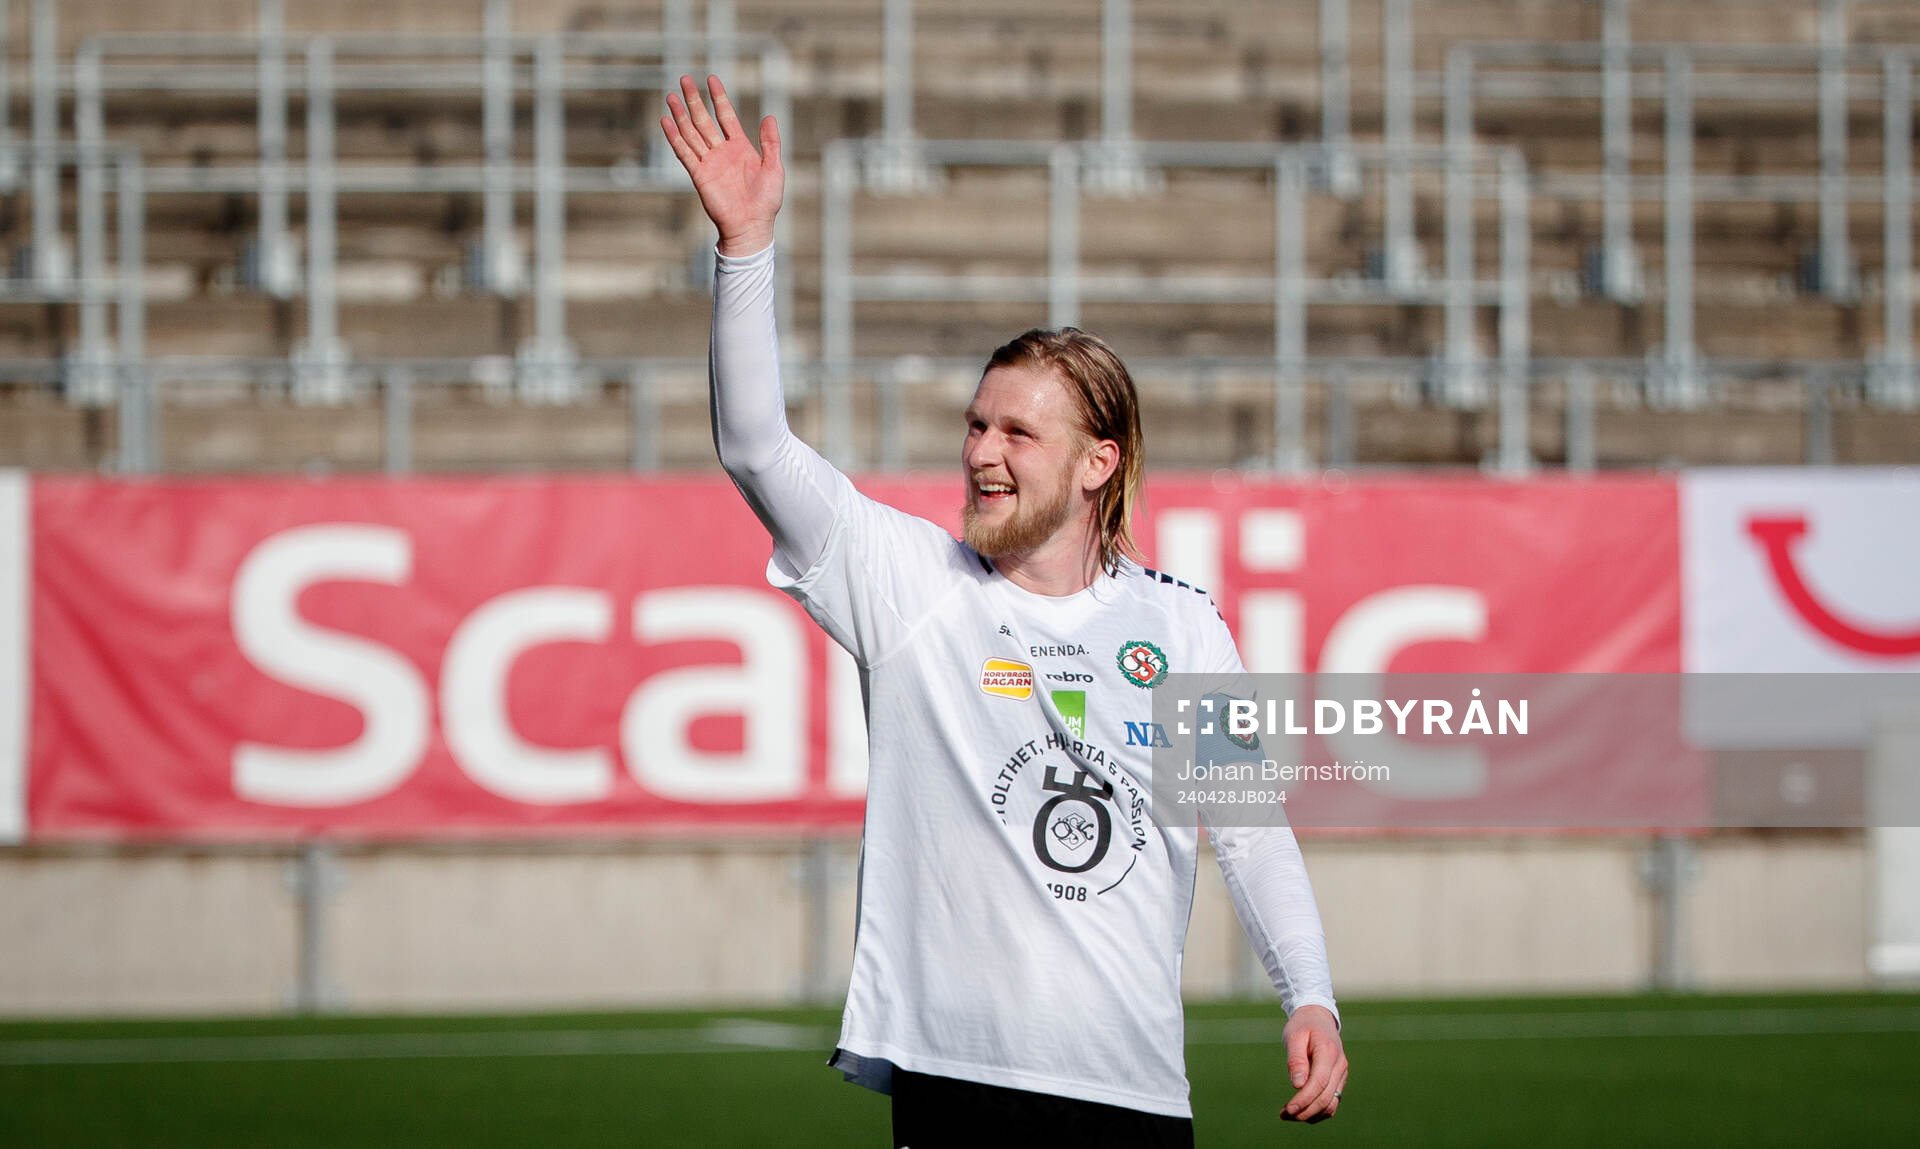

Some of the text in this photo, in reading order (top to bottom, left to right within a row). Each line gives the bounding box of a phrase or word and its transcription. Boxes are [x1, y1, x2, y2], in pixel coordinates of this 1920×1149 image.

[983, 678, 1031, 686] BAGARN
[1123, 721, 1173, 748] NA
[1120, 776, 1147, 852] PASSION
